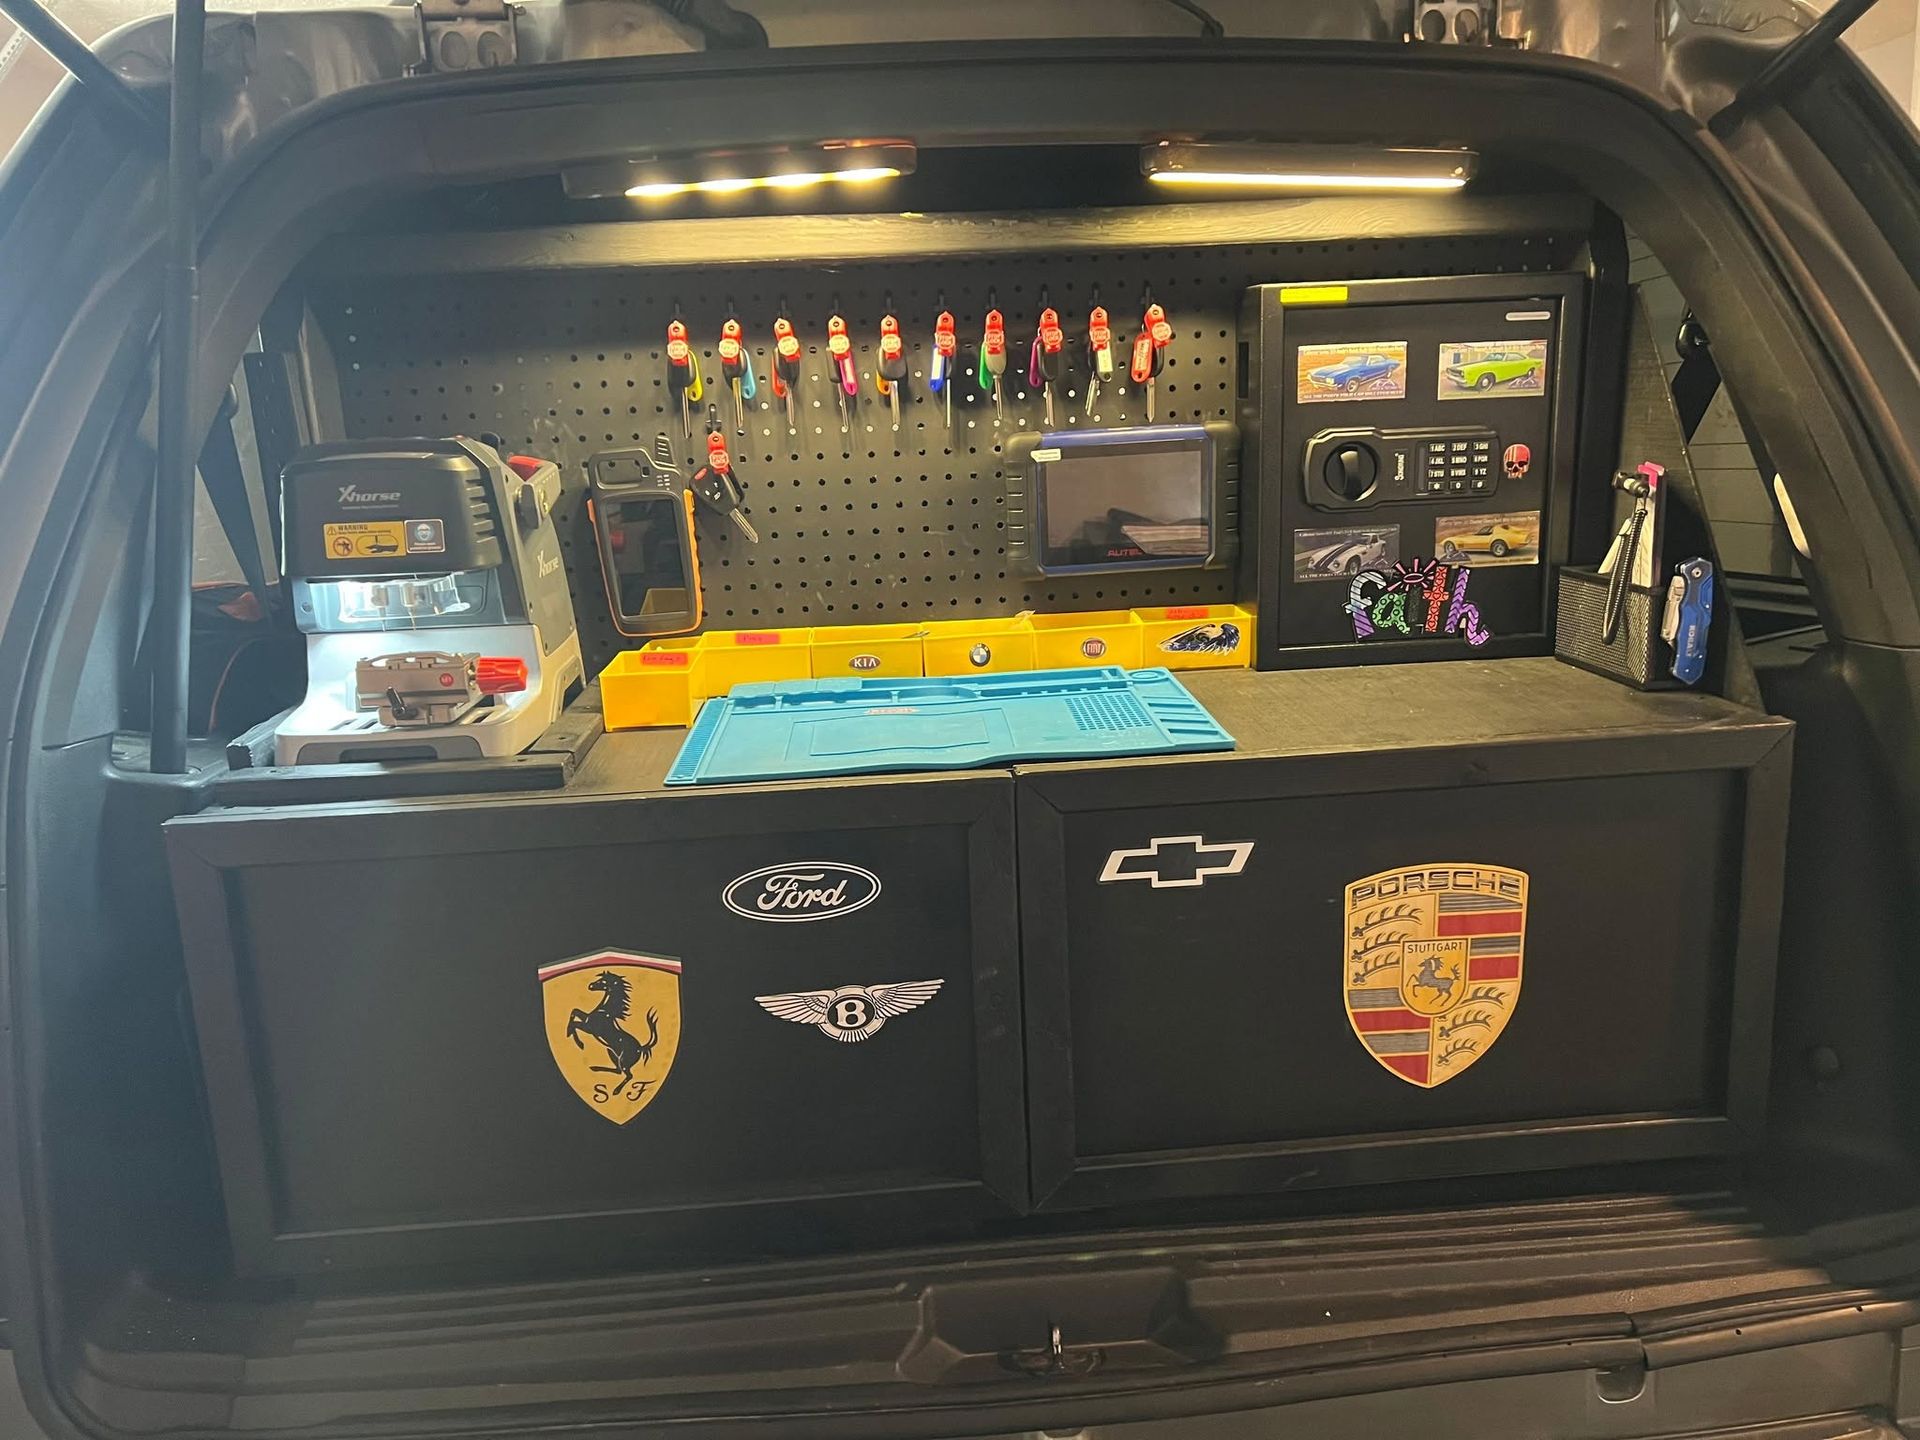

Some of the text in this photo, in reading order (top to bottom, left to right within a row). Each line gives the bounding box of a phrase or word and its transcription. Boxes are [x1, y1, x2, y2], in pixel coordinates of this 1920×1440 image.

[338, 484, 401, 503] Xhorse
[854, 658, 877, 668] KIA
[757, 873, 848, 911] Ford
[1351, 870, 1521, 910] PORSCHE
[1407, 941, 1463, 954] STUTTGART
[835, 999, 867, 1028] B
[593, 1079, 657, 1104] S F
